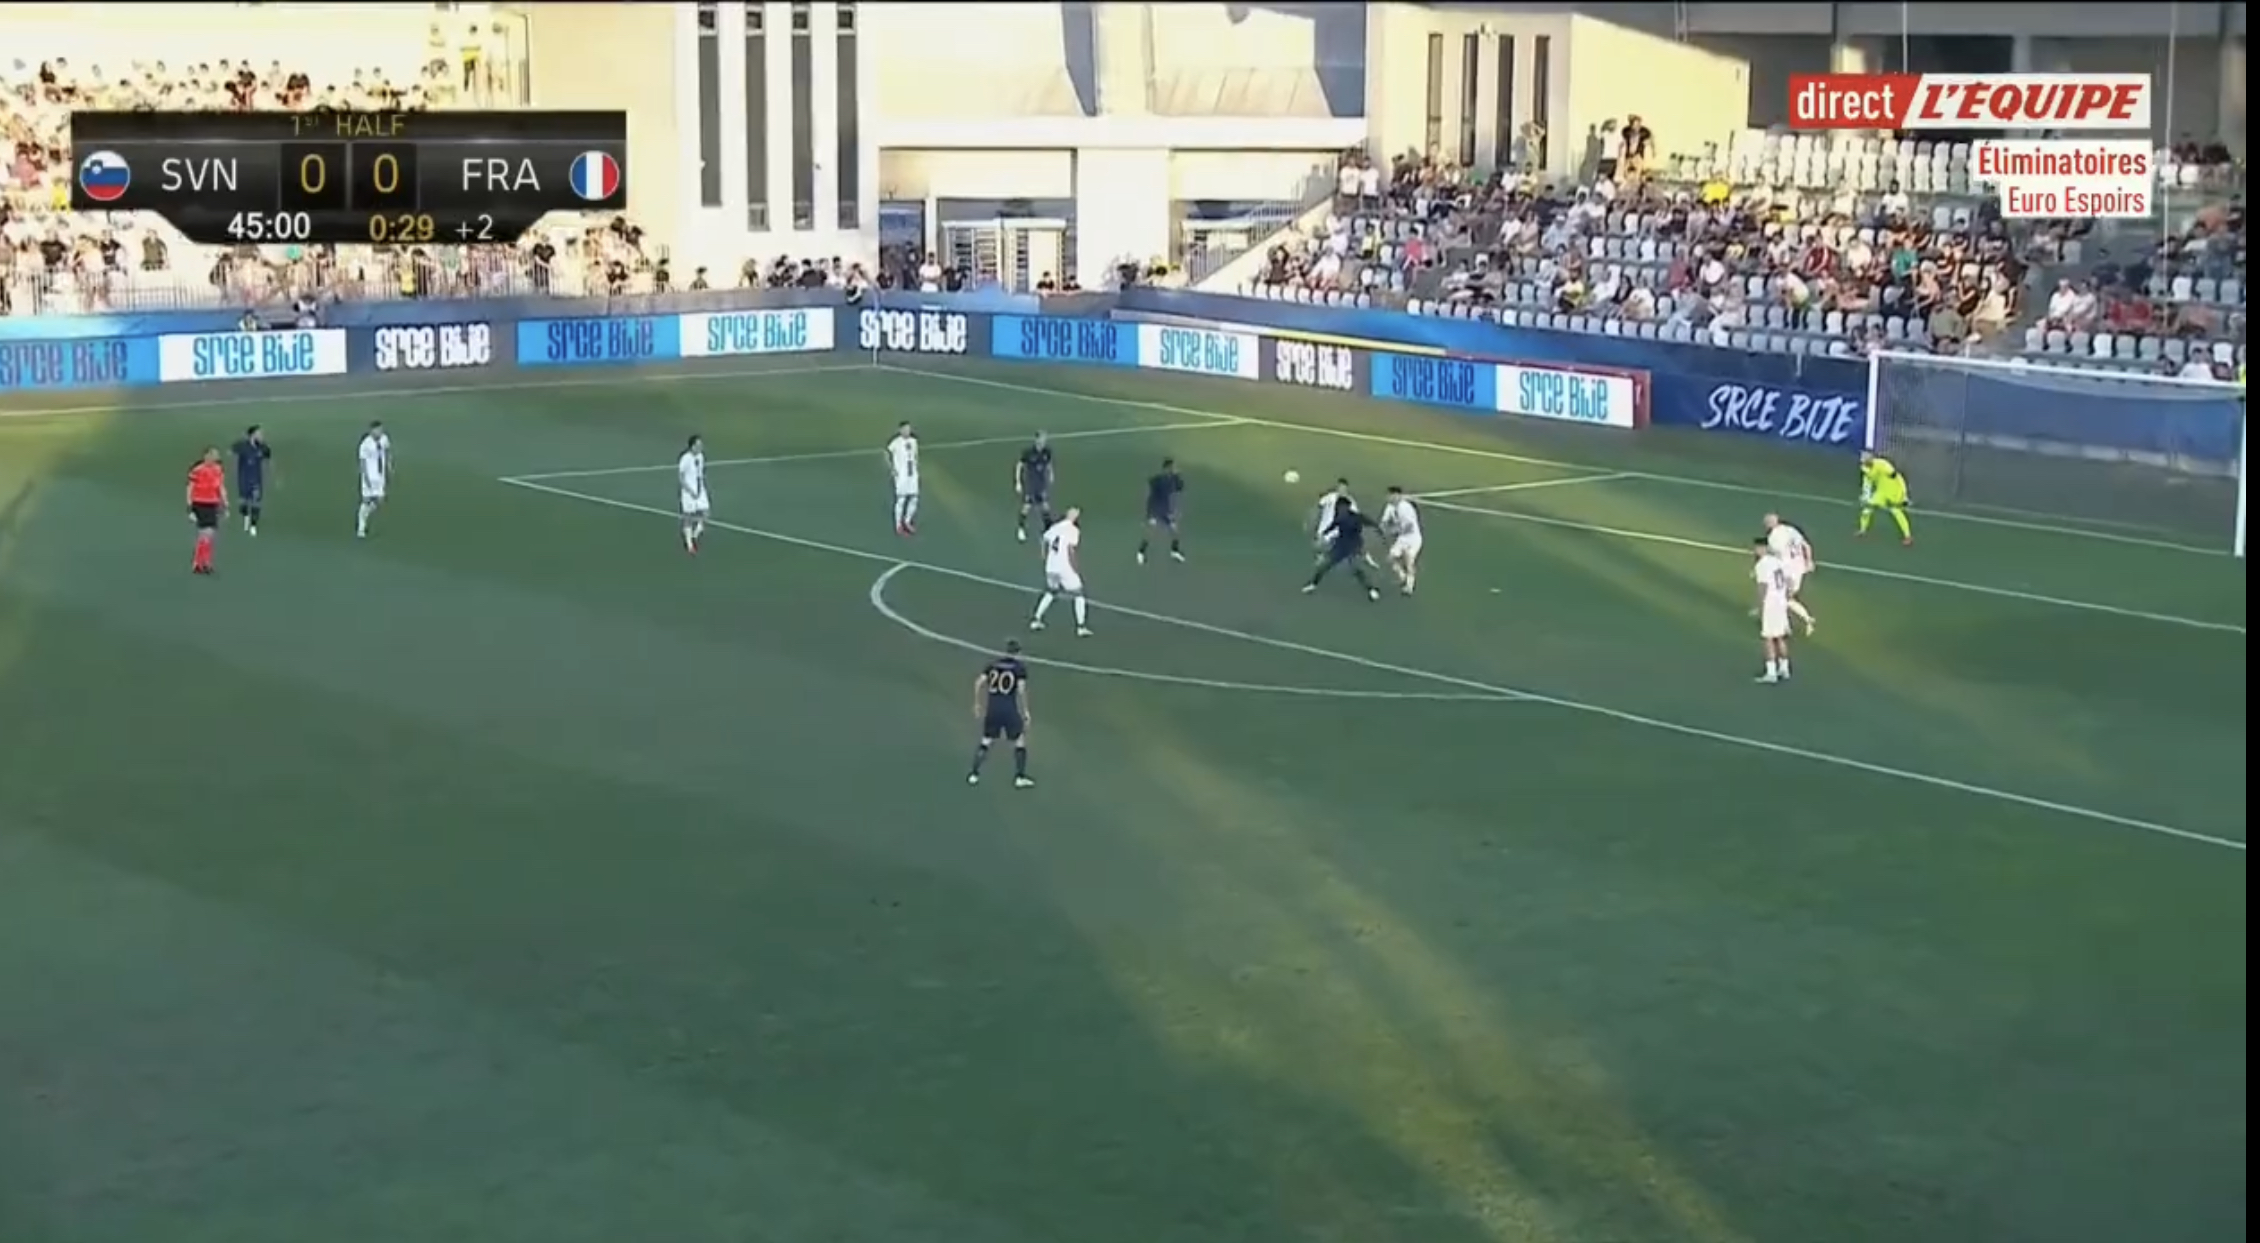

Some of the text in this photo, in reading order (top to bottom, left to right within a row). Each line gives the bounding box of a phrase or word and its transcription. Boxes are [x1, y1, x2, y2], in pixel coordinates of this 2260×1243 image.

[1701, 385, 1859, 442] SRCE BIJE
[989, 669, 1016, 694] 20
